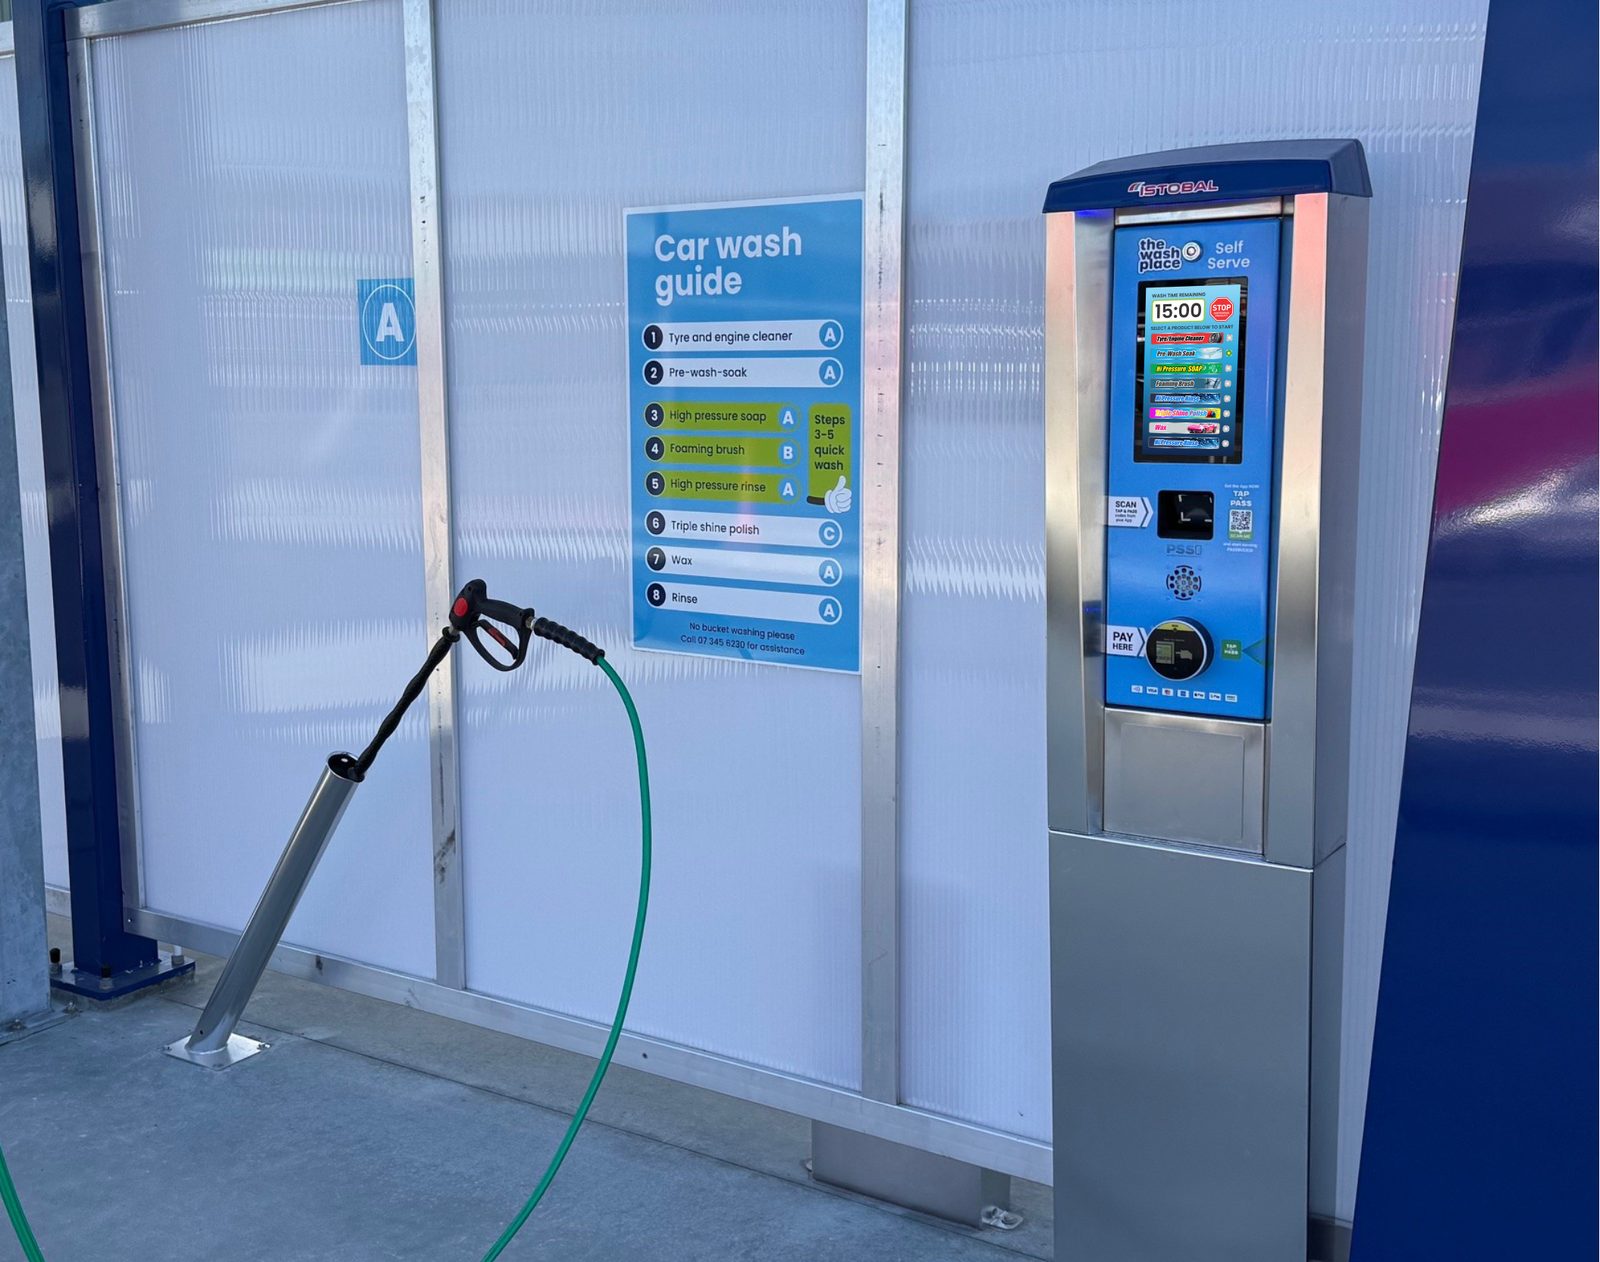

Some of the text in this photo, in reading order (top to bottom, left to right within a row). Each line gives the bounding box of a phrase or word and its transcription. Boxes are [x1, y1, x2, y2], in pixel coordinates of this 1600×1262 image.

[1139, 180, 1218, 197] ISTOBAL
[654, 226, 802, 262] Car wash
[1140, 239, 1165, 250] the
[1215, 240, 1244, 254] Self
[1140, 247, 1180, 259] wash
[1140, 258, 1181, 272] place
[1207, 256, 1250, 270] Serve
[654, 265, 742, 306] guide
[1155, 302, 1202, 319] 15:00
[375, 302, 405, 342] A
[650, 328, 837, 346] 1 Tyre and engine cleaner A
[650, 365, 837, 379] 2 Pre-wash-soak A
[651, 409, 794, 425] 3 High pressure soap A
[814, 414, 845, 426] Steps
[814, 429, 834, 440] 3-5
[651, 443, 793, 459] 4 Foaming brush B
[814, 445, 845, 457] quick
[814, 460, 844, 471] wash
[652, 478, 794, 496] 5 High pressure rinse A
[1115, 500, 1137, 508] SCAN
[652, 517, 835, 540] 6 Triple shine polish C
[653, 554, 835, 579] 7 Wax A
[653, 589, 835, 617] 8 Rinse A
[689, 622, 795, 640] No bucket washing please
[1112, 631, 1134, 642] PAY
[680, 634, 805, 656] Call 07 345 6230 for assistance
[1112, 643, 1133, 651] HERE
